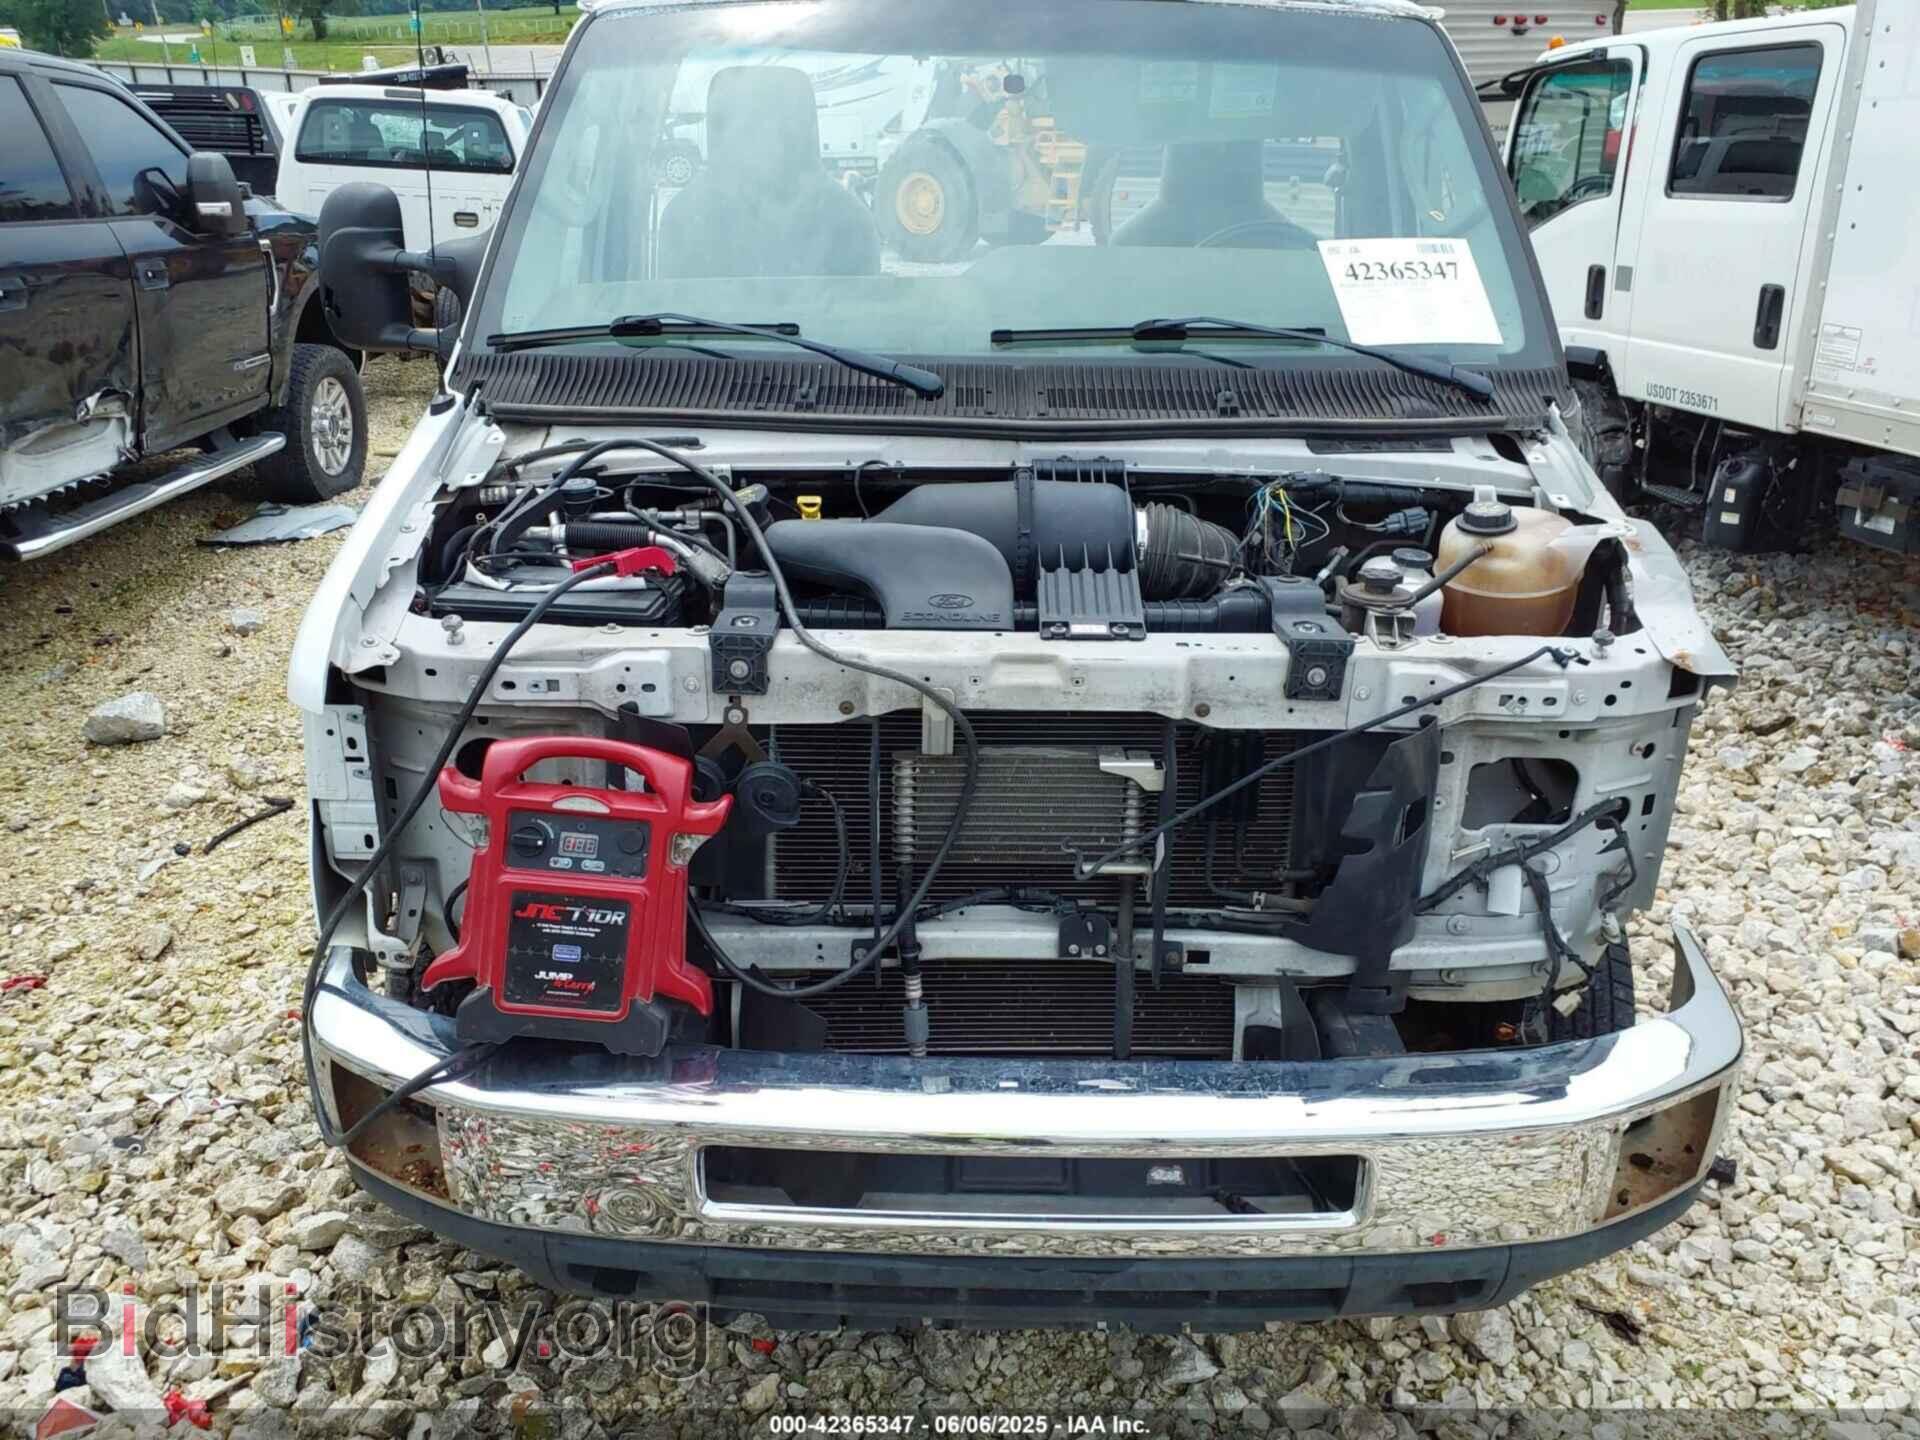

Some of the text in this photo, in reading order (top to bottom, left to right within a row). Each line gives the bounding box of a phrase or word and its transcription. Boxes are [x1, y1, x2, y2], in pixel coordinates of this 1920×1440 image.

[1345, 261, 1459, 281] 42365347
[1646, 382, 1719, 413] USDOT 2353671
